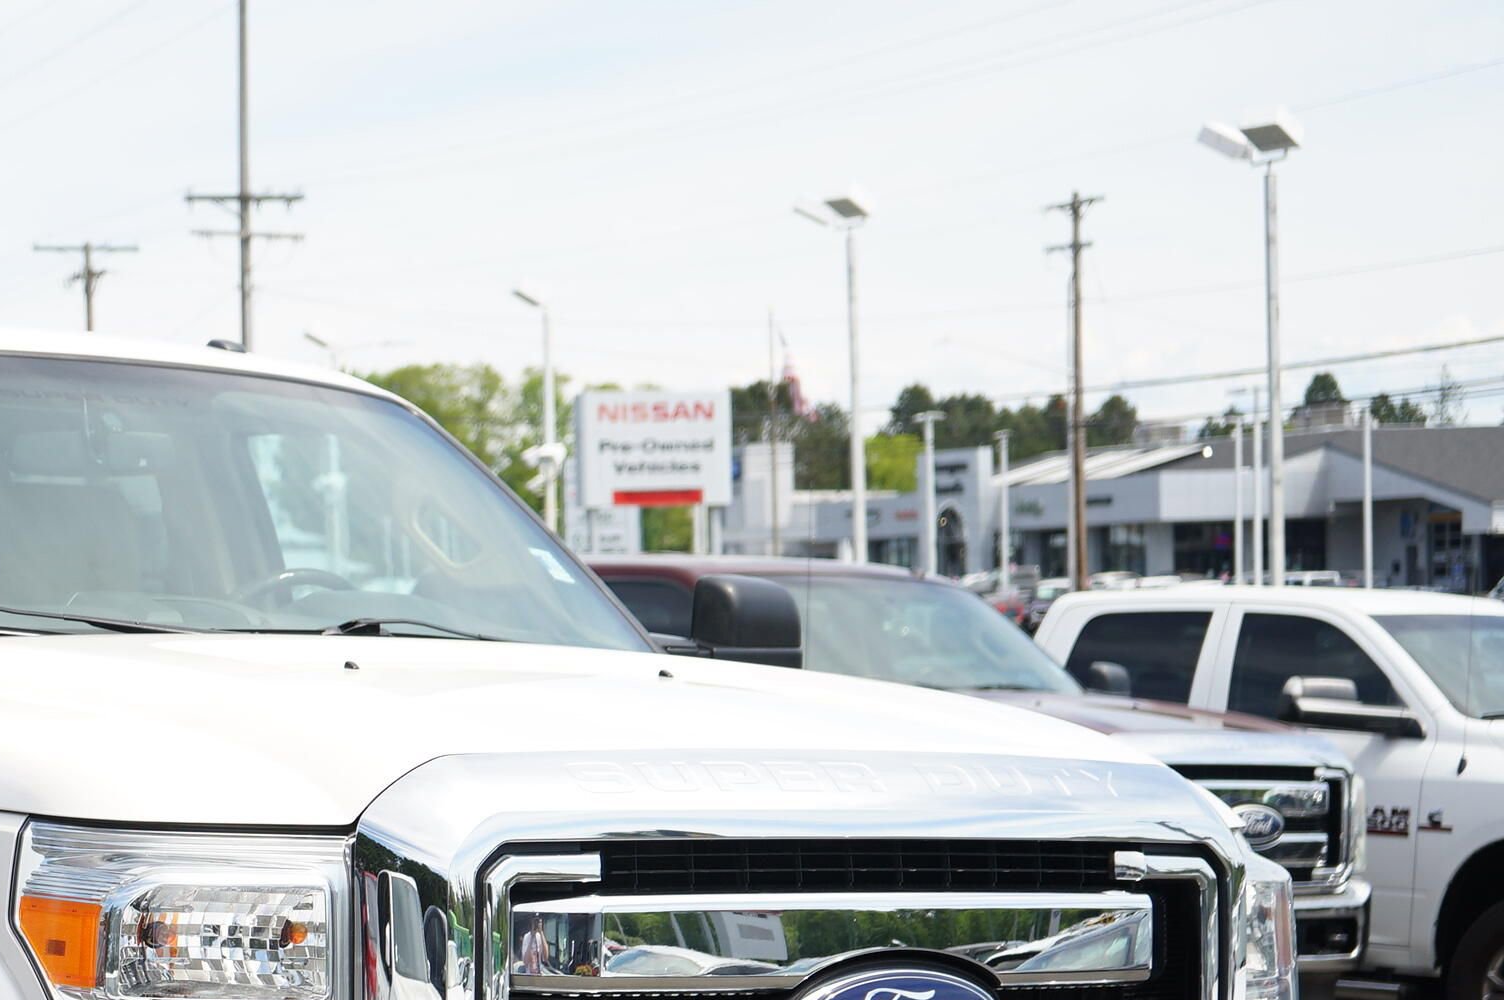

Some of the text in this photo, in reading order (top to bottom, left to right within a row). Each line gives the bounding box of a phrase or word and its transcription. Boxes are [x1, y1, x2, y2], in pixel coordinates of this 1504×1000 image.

[597, 402, 714, 423] NISSAN
[563, 760, 1121, 798] SUPER DUTY
